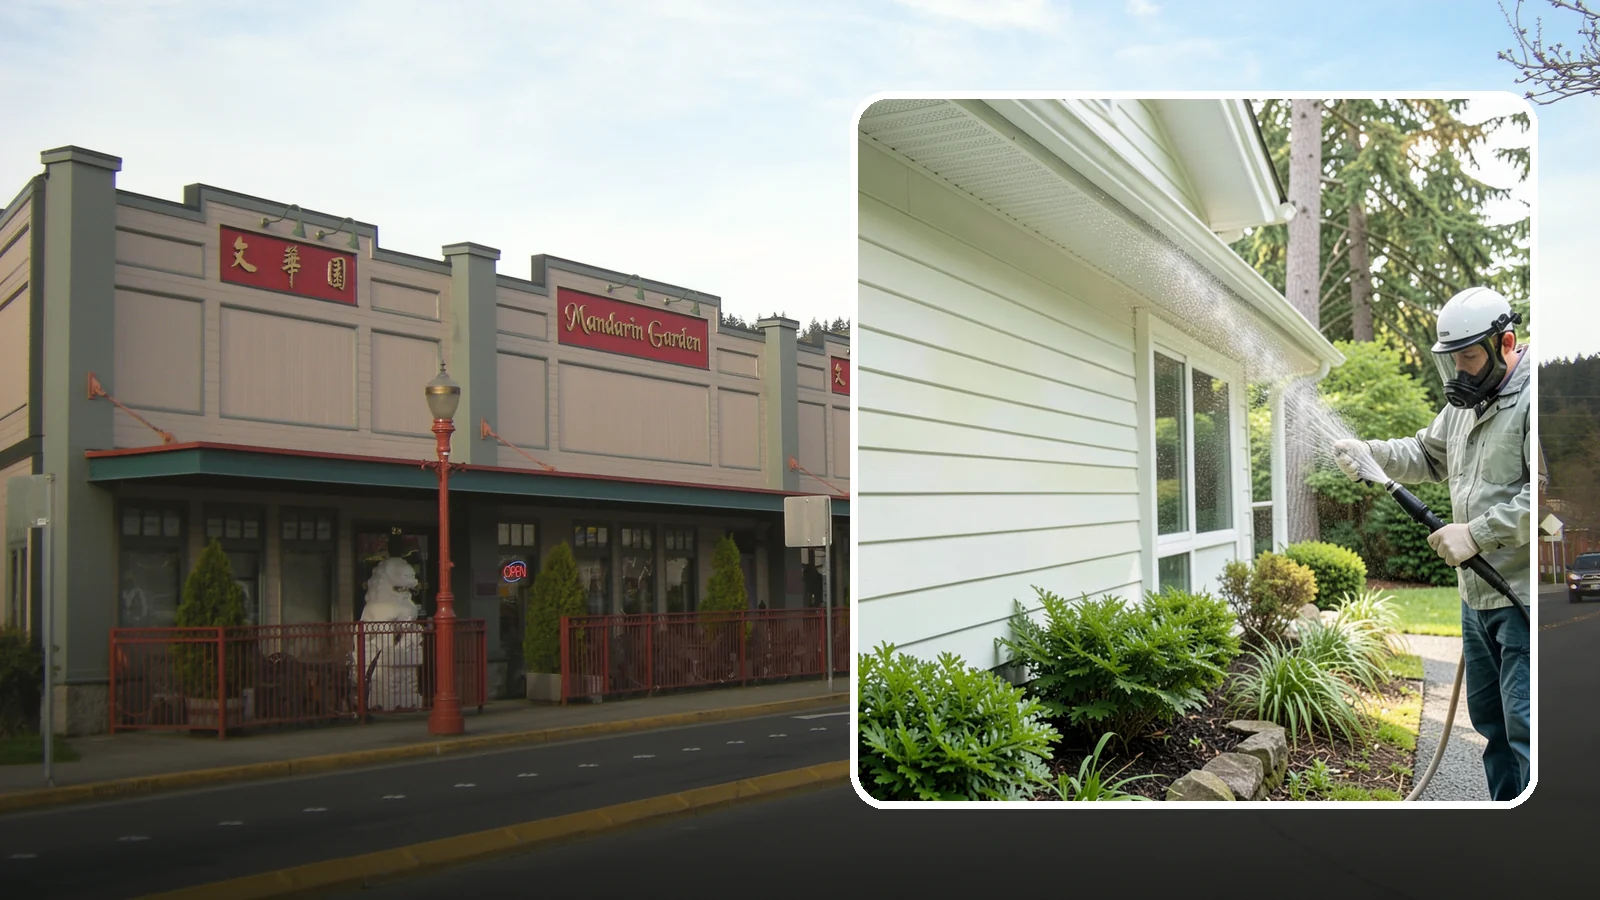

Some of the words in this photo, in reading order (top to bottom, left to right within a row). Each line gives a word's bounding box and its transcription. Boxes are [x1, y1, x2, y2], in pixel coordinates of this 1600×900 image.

[230, 235, 347, 291] 文華園
[564, 302, 644, 341] Mandarin
[647, 320, 702, 352] Garden
[503, 565, 527, 578] OPEN
